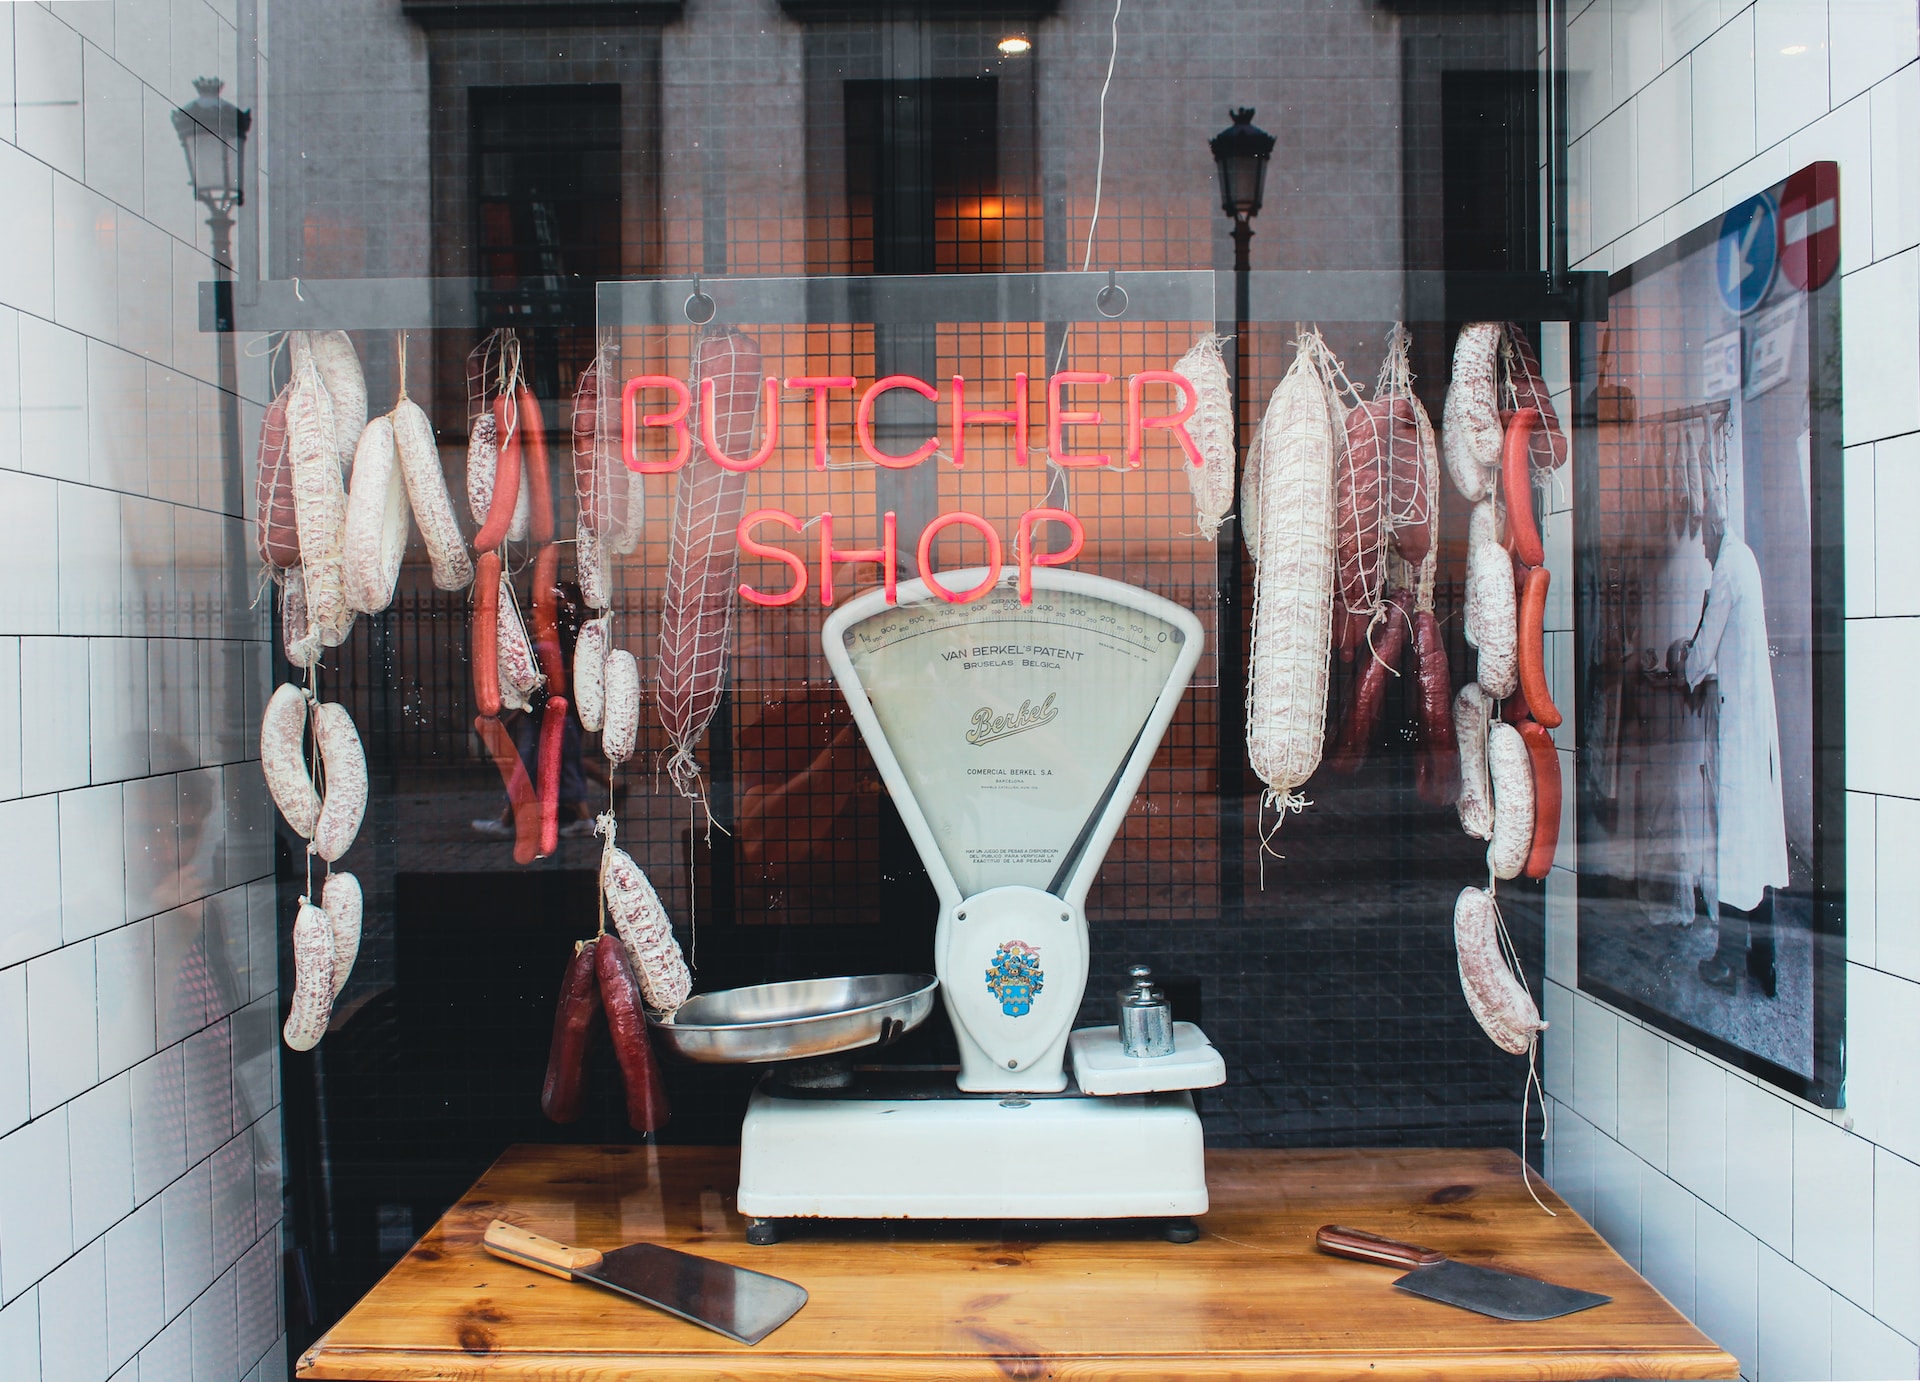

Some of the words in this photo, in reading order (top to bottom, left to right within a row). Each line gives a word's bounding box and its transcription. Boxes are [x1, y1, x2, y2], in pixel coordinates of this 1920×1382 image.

[622, 370, 1204, 474] BUTCHER
[737, 508, 1085, 606] SHOP
[880, 624, 897, 634] 900
[909, 616, 925, 624] 800
[940, 608, 956, 616] 700
[971, 604, 987, 612] 600
[1003, 603, 1022, 611] 500
[1037, 604, 1054, 612] 400
[1069, 608, 1086, 617] 300
[1100, 615, 1116, 624] 200
[1130, 624, 1143, 634] 100
[1157, 632, 1167, 643] 0
[941, 648, 968, 661] VAN
[972, 645, 1032, 657] BERKEL'S
[1033, 646, 1084, 662] PATENT
[963, 660, 1014, 670] BRUSELAS
[1022, 659, 1061, 670] BELGICA
[966, 692, 1059, 747] Berkel
[967, 768, 1007, 776] COMERCIAL
